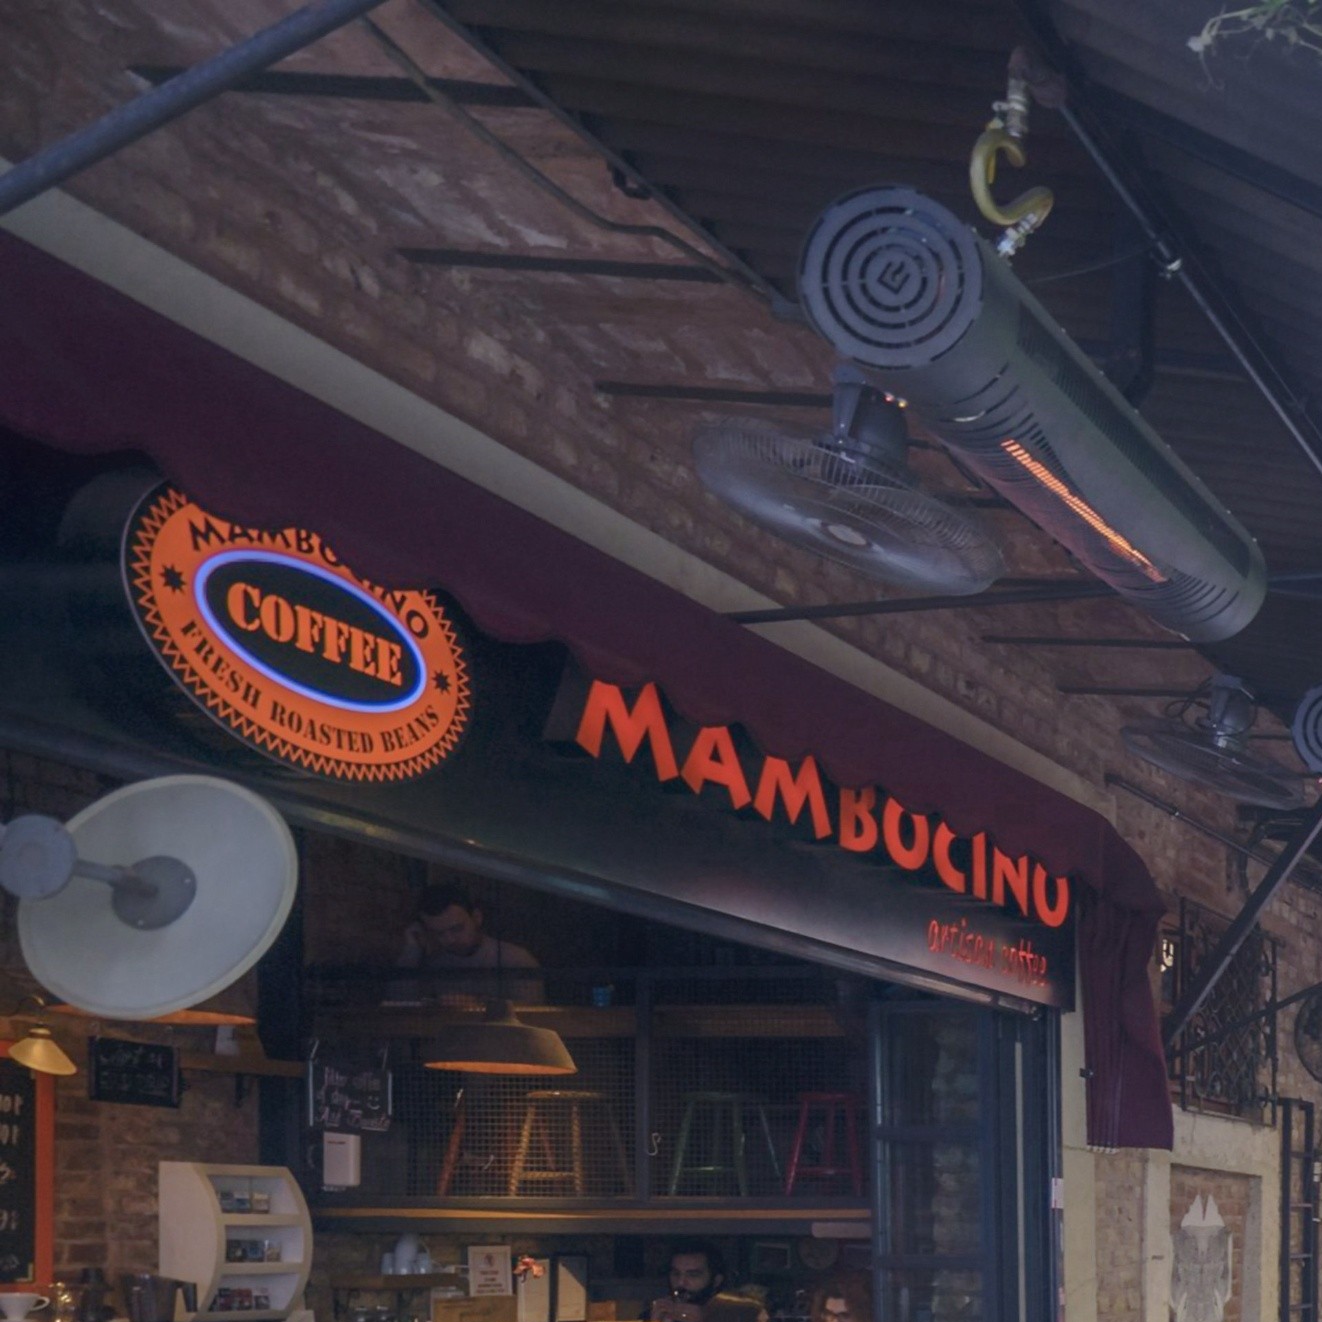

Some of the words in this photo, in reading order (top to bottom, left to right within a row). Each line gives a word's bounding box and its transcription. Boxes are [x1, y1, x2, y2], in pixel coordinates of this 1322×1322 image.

[180, 619, 262, 710] FRESH
[271, 703, 374, 754] ROASTED
[379, 705, 440, 752] BEANS
[227, 582, 403, 687] COFFEE
